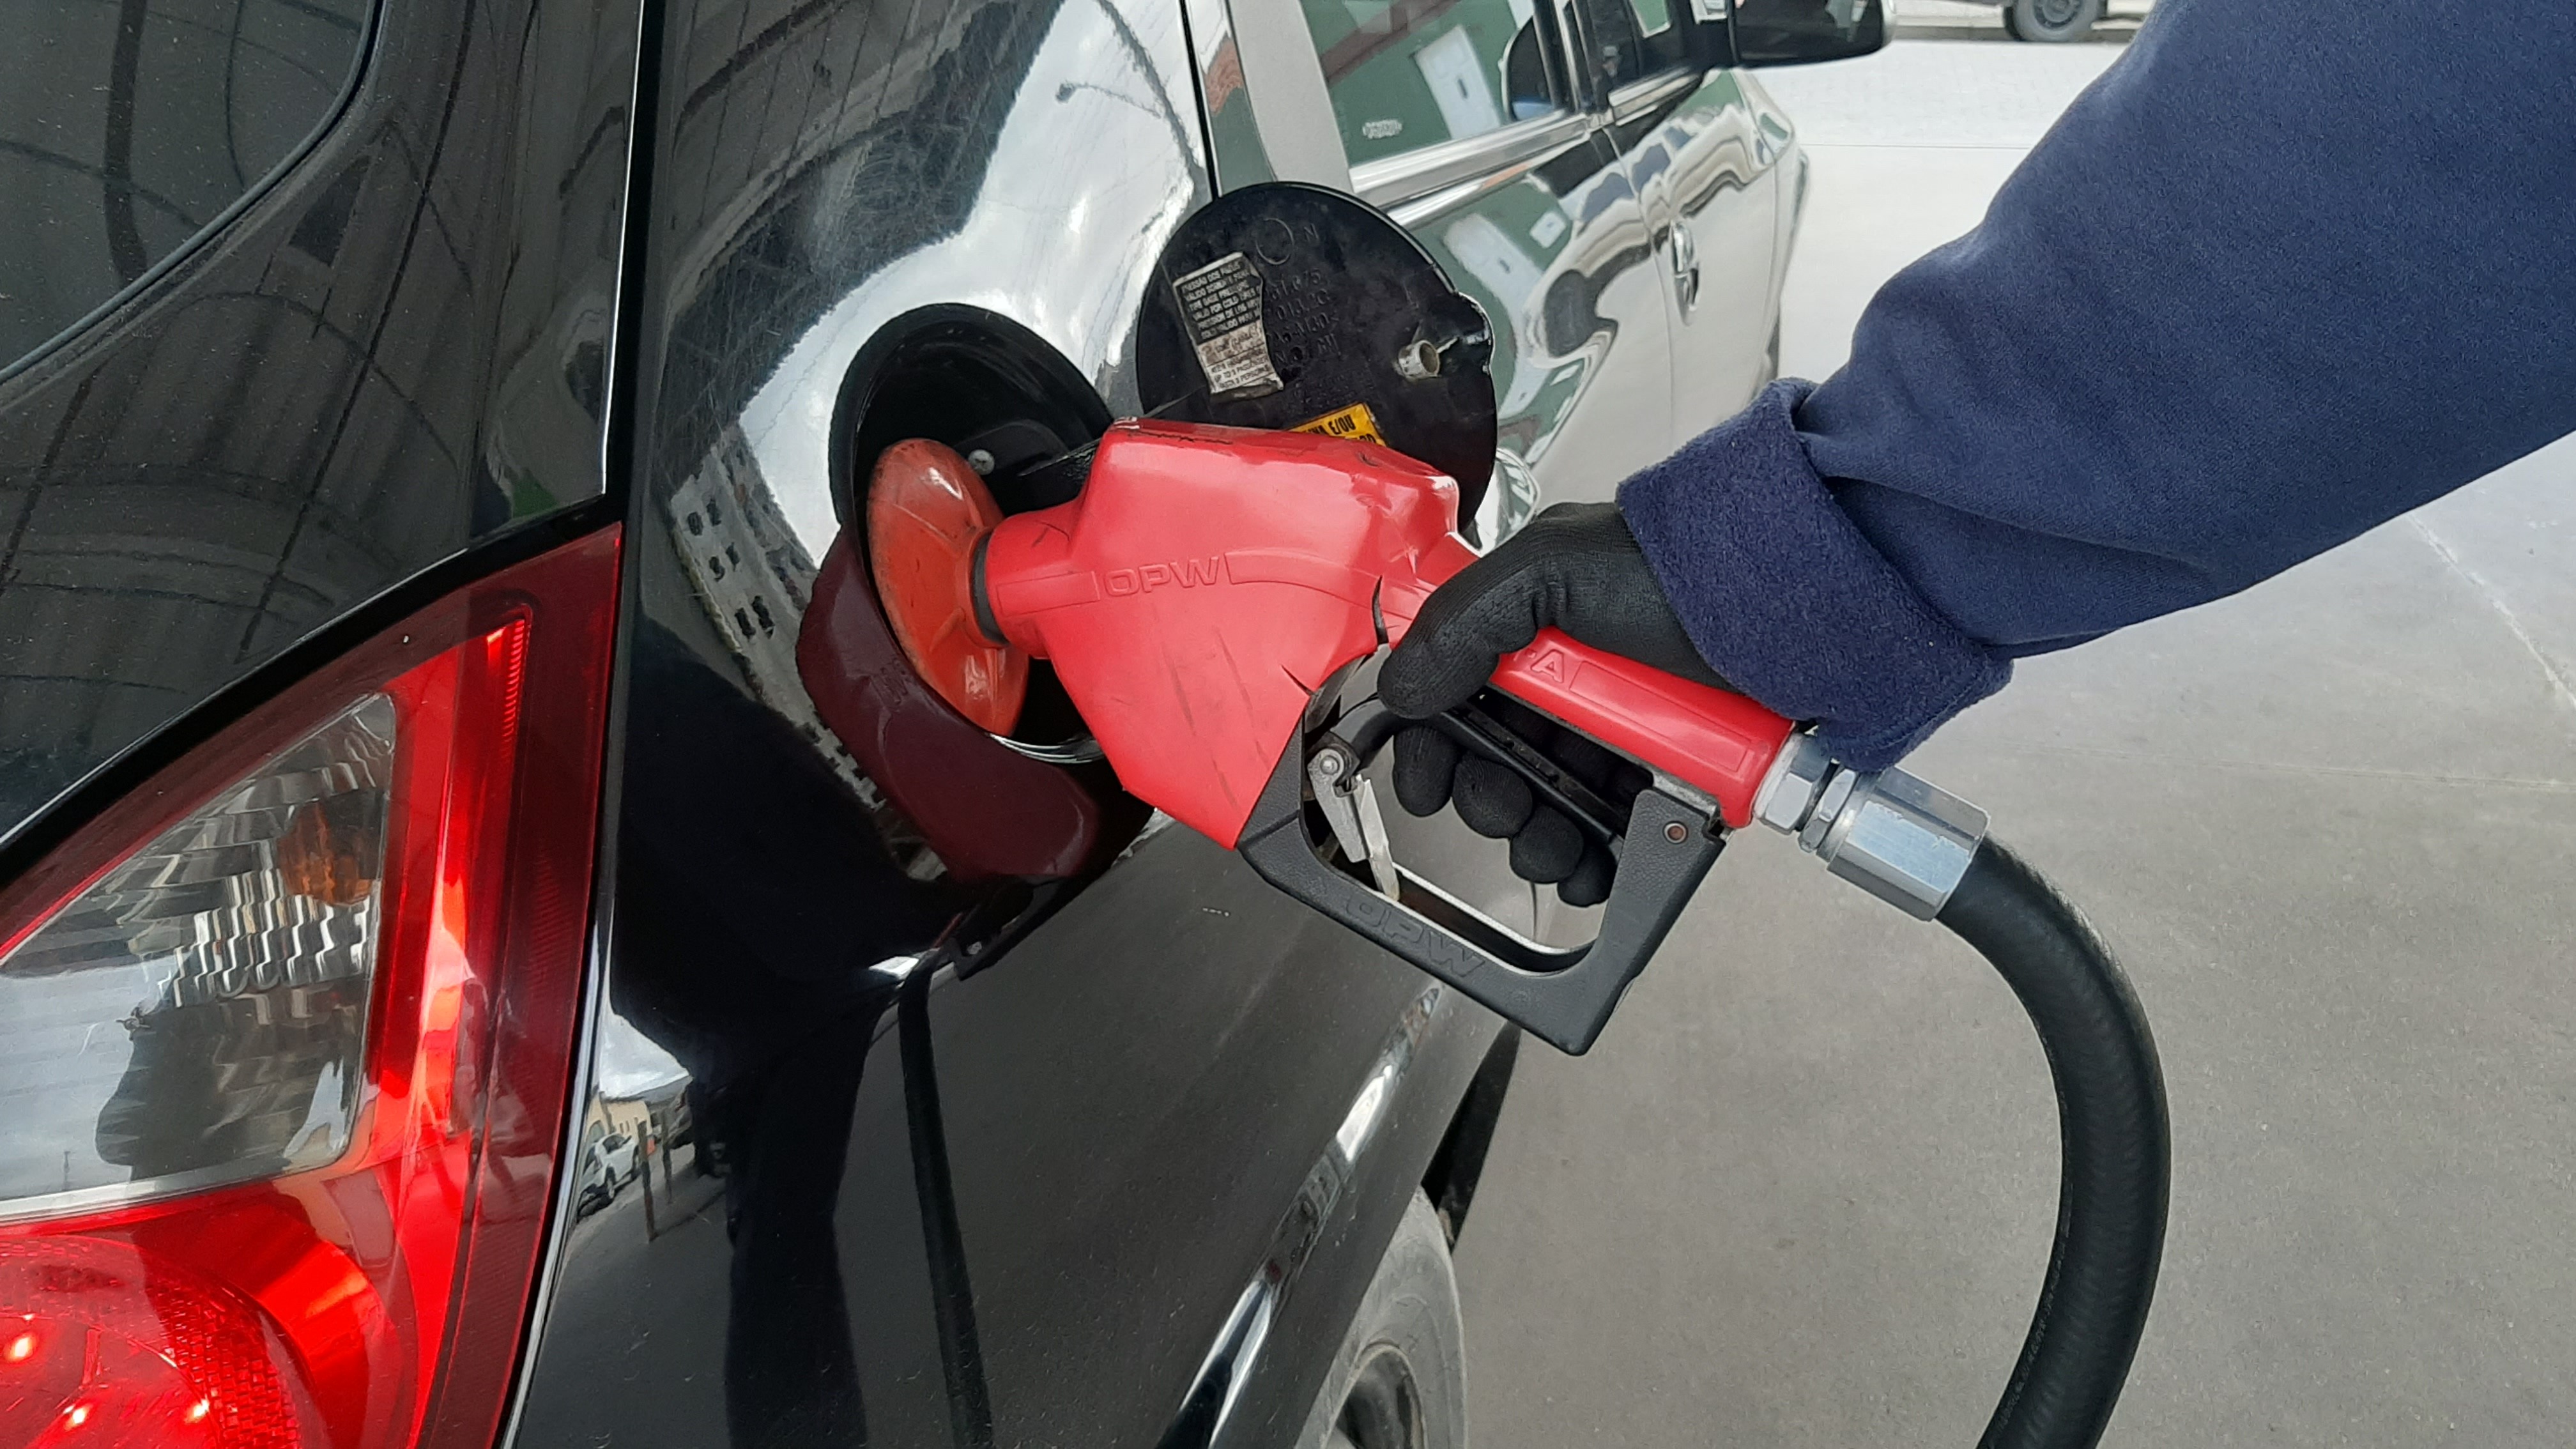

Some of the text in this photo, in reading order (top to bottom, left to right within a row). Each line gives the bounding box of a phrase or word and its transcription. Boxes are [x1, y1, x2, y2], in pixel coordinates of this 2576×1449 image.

[1328, 414, 1356, 434] E/OU
[1103, 556, 1220, 597] OPW
[1345, 893, 1486, 978] OPW
